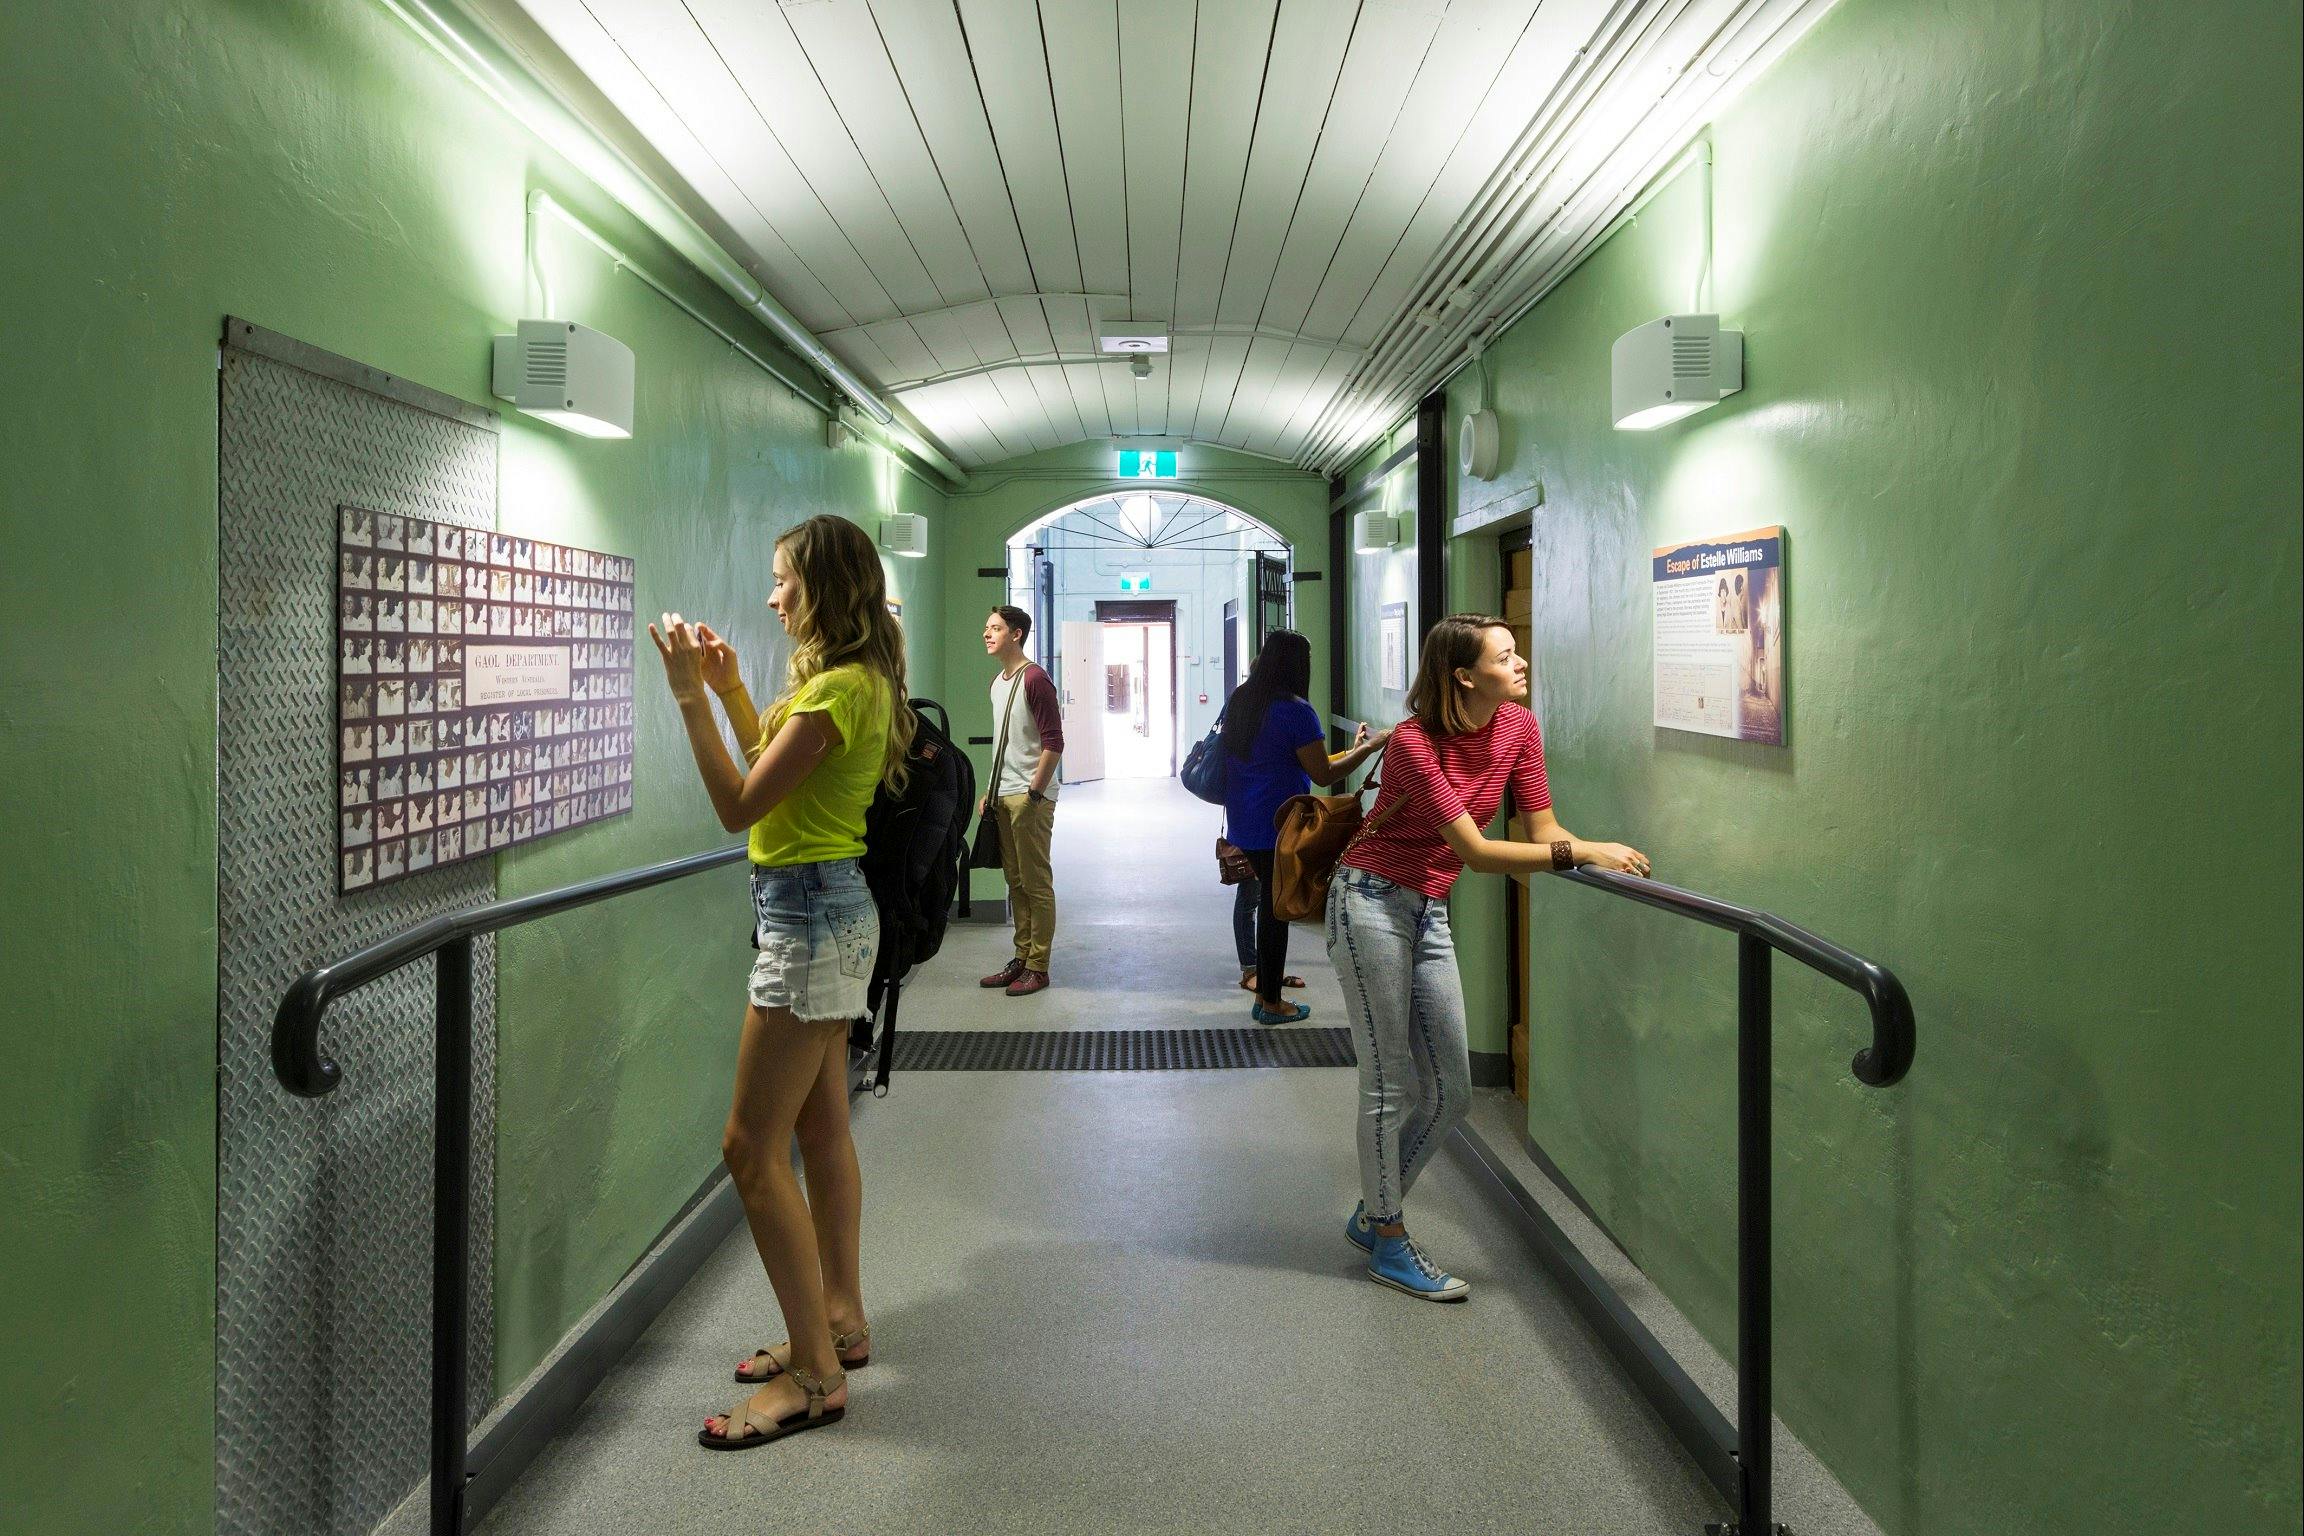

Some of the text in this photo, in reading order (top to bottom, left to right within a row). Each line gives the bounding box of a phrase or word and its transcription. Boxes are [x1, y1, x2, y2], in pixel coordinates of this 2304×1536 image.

[1667, 546, 1763, 575] Escape of Estelle Williams
[475, 655, 500, 668] GAOL
[480, 691, 505, 700] REGISTER
